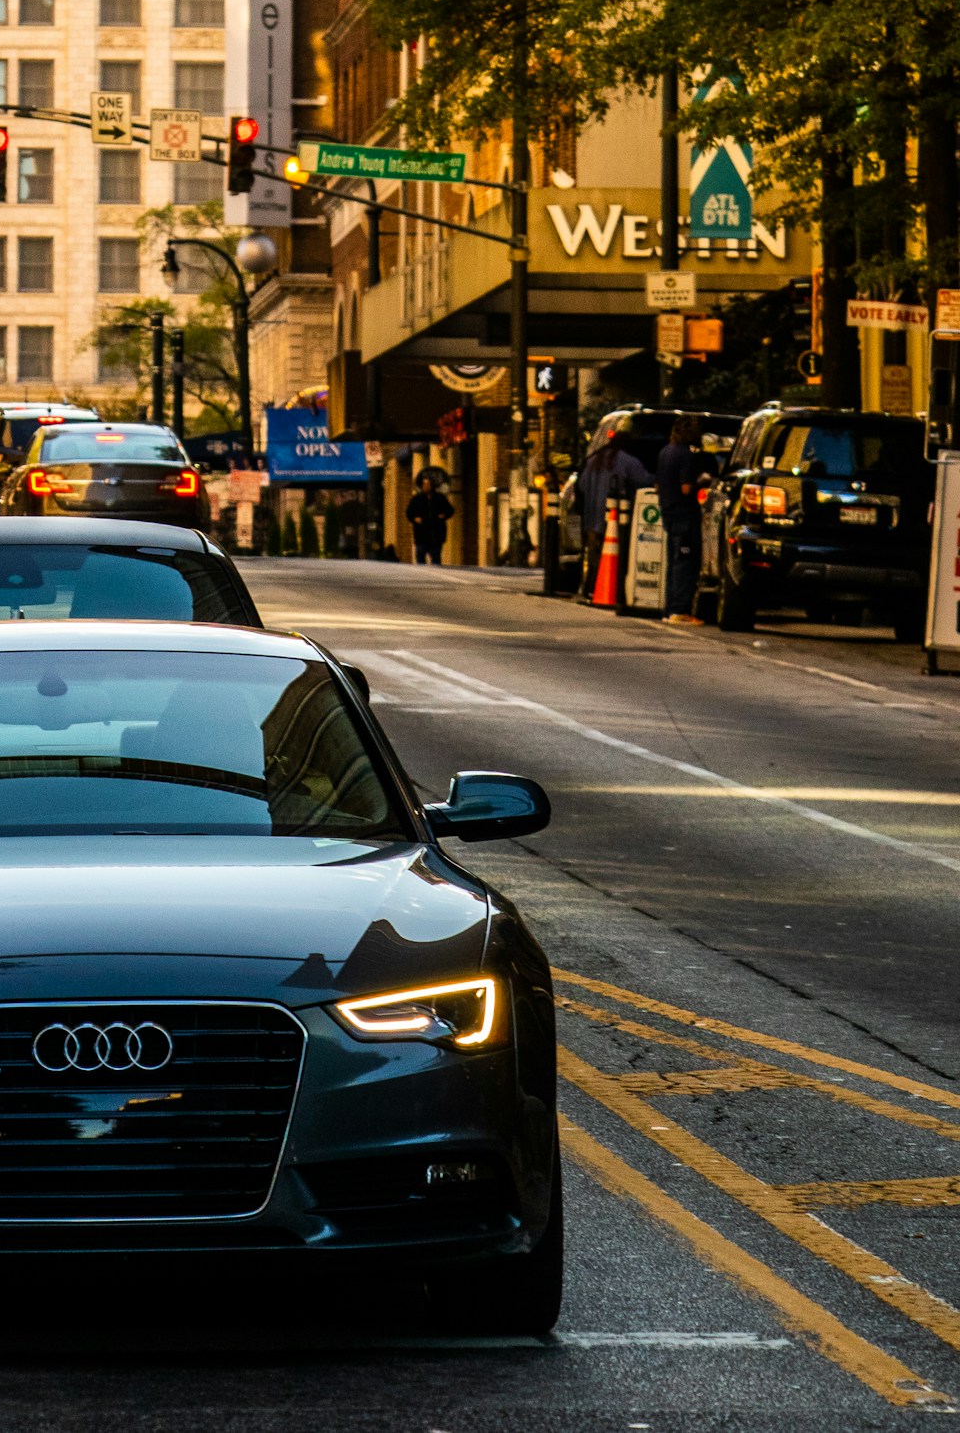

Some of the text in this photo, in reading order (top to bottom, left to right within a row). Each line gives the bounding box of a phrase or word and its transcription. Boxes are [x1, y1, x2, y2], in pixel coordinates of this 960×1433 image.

[97, 97, 123, 108] ONE
[97, 110, 124, 122] WAY
[151, 112, 198, 122] DON'T BLOCK
[155, 148, 196, 159] THE BOX
[320, 151, 355, 170] Andrew
[358, 153, 386, 176] Young
[704, 194, 738, 209] ATL
[702, 209, 739, 226] DTN
[849, 308, 928, 324] VOTE EARLY
[295, 443, 341, 457] OPEN
